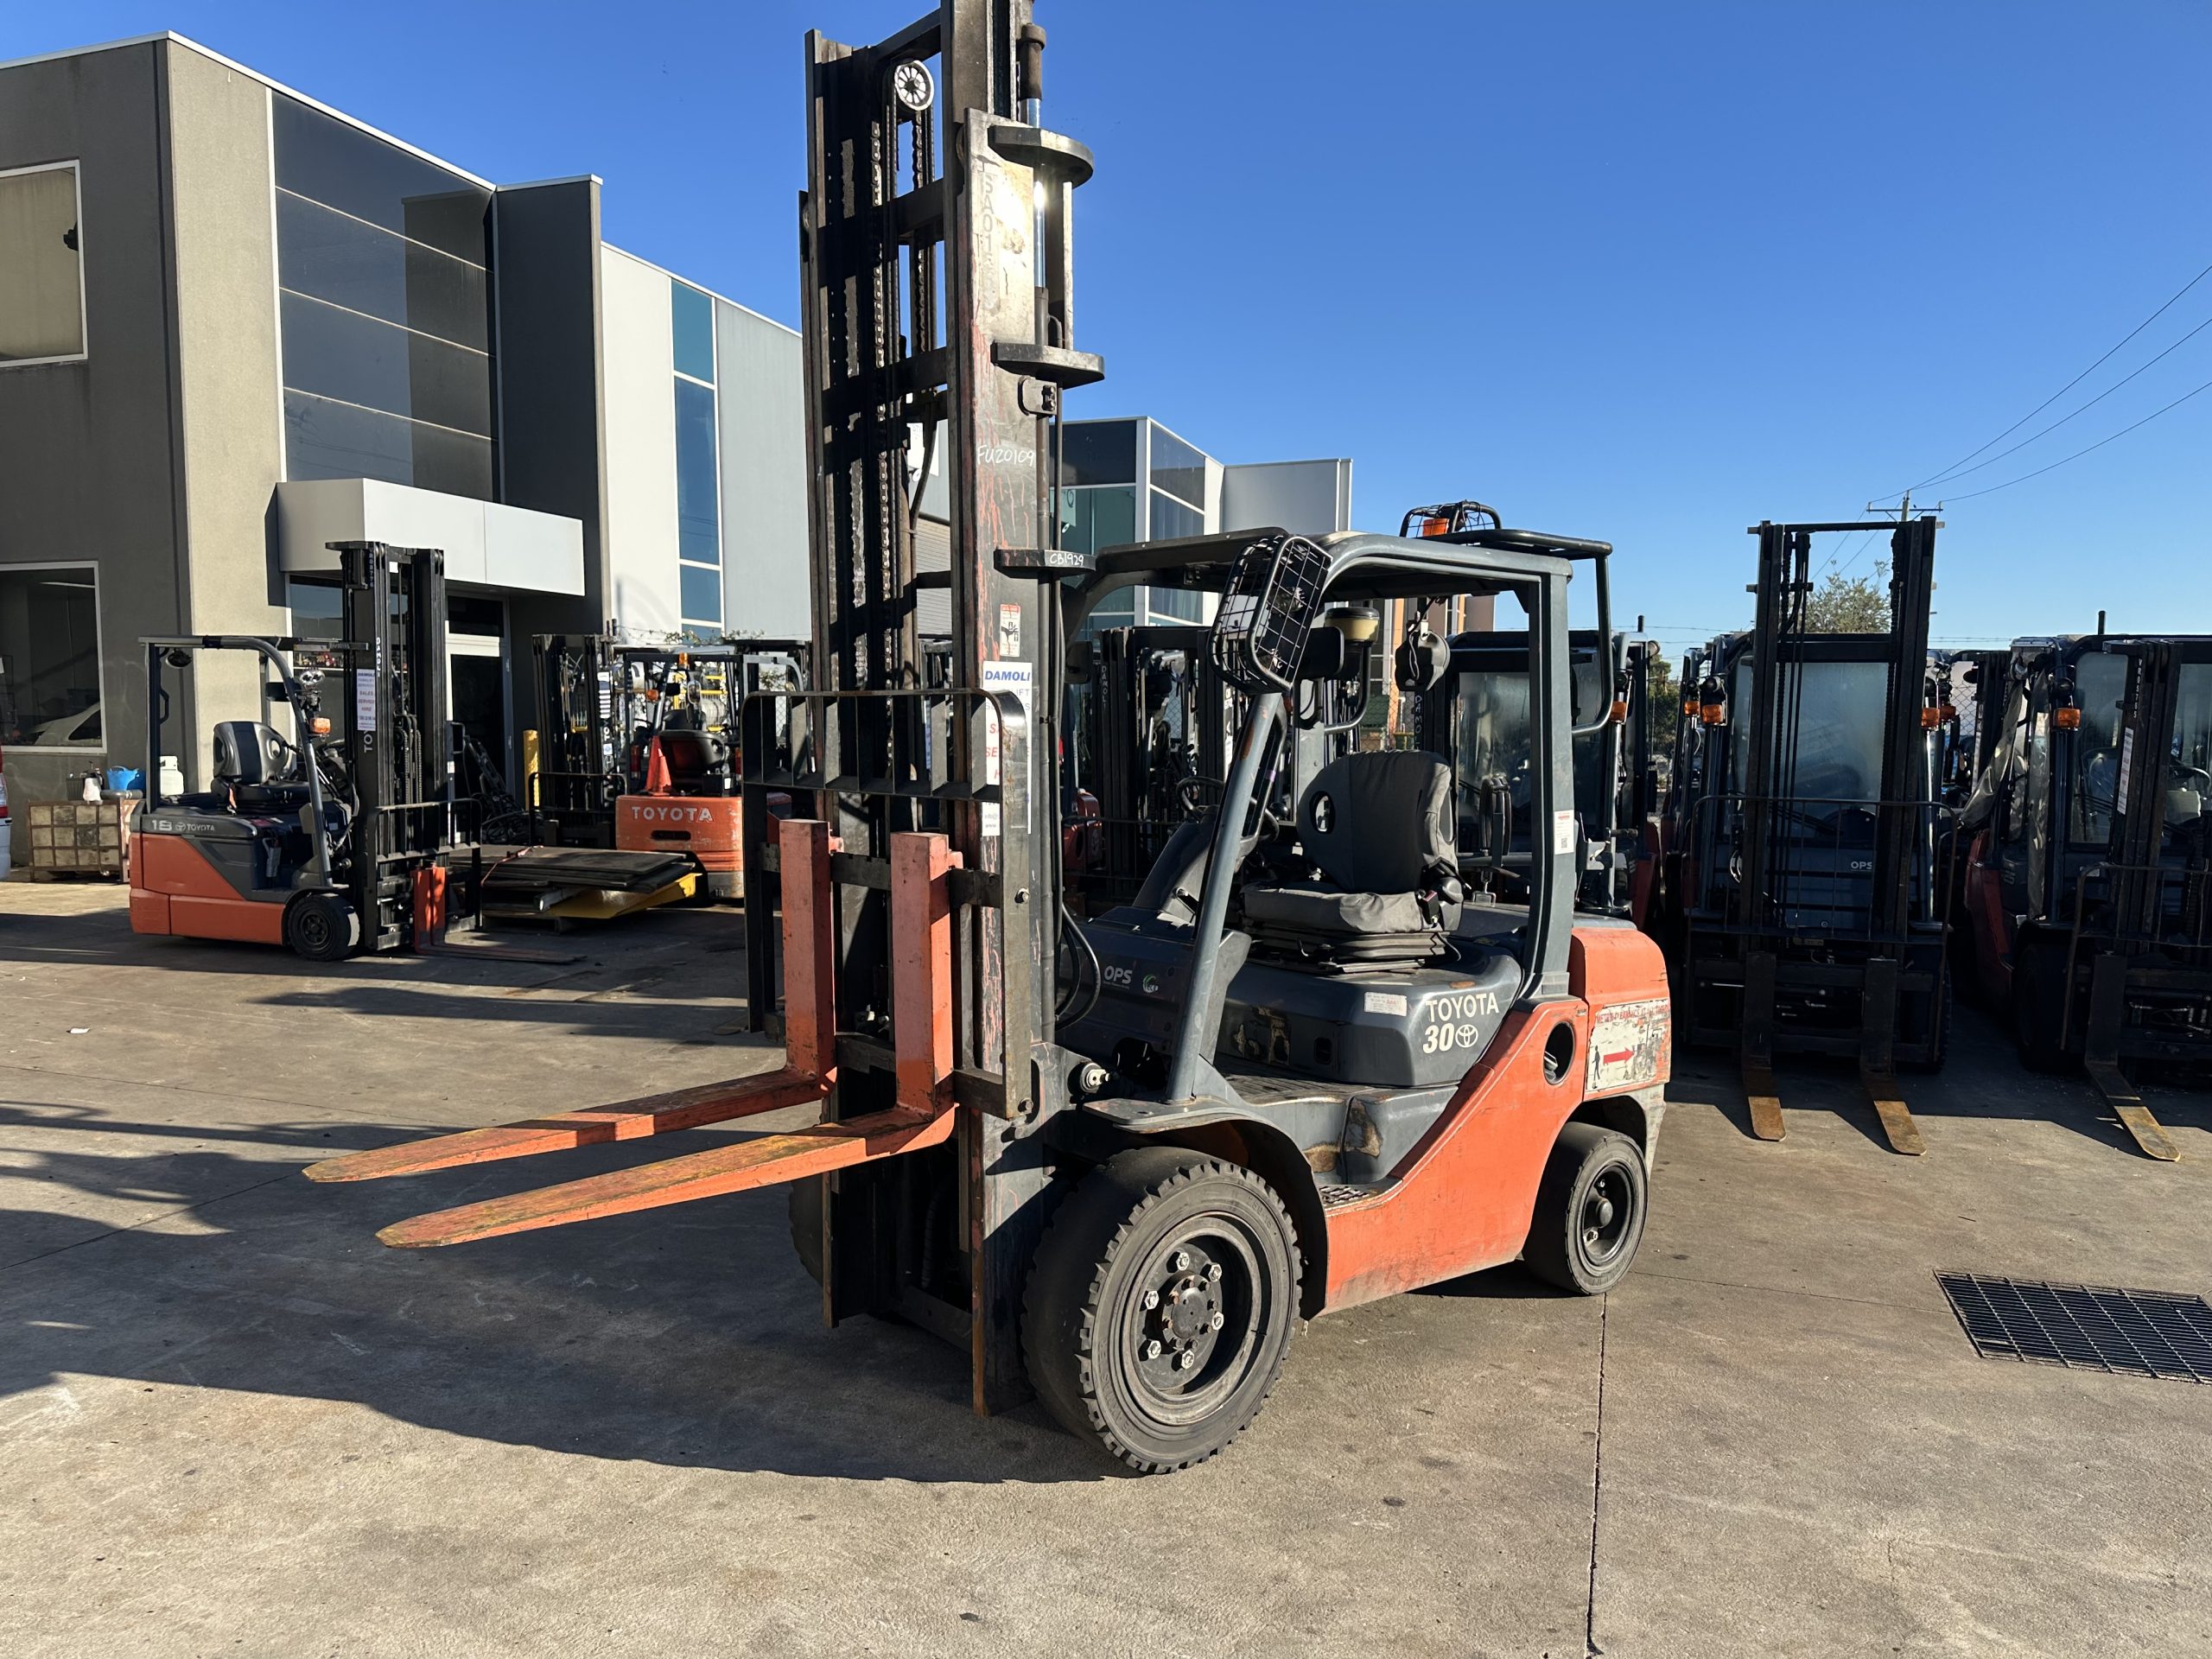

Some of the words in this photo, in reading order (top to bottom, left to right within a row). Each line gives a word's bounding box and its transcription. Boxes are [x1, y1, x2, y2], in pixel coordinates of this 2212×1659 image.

[976, 444, 1036, 467] FU20109
[1049, 553, 1084, 566] CB1929
[984, 670, 1031, 682] DAMOLI
[632, 806, 714, 823] TOYOTA
[152, 820, 172, 831] 18
[1850, 861, 1872, 869] OPS
[1104, 965, 1133, 984] OPS
[1426, 992, 1499, 1023] TOYOTA
[1422, 1022, 1455, 1054] 30
